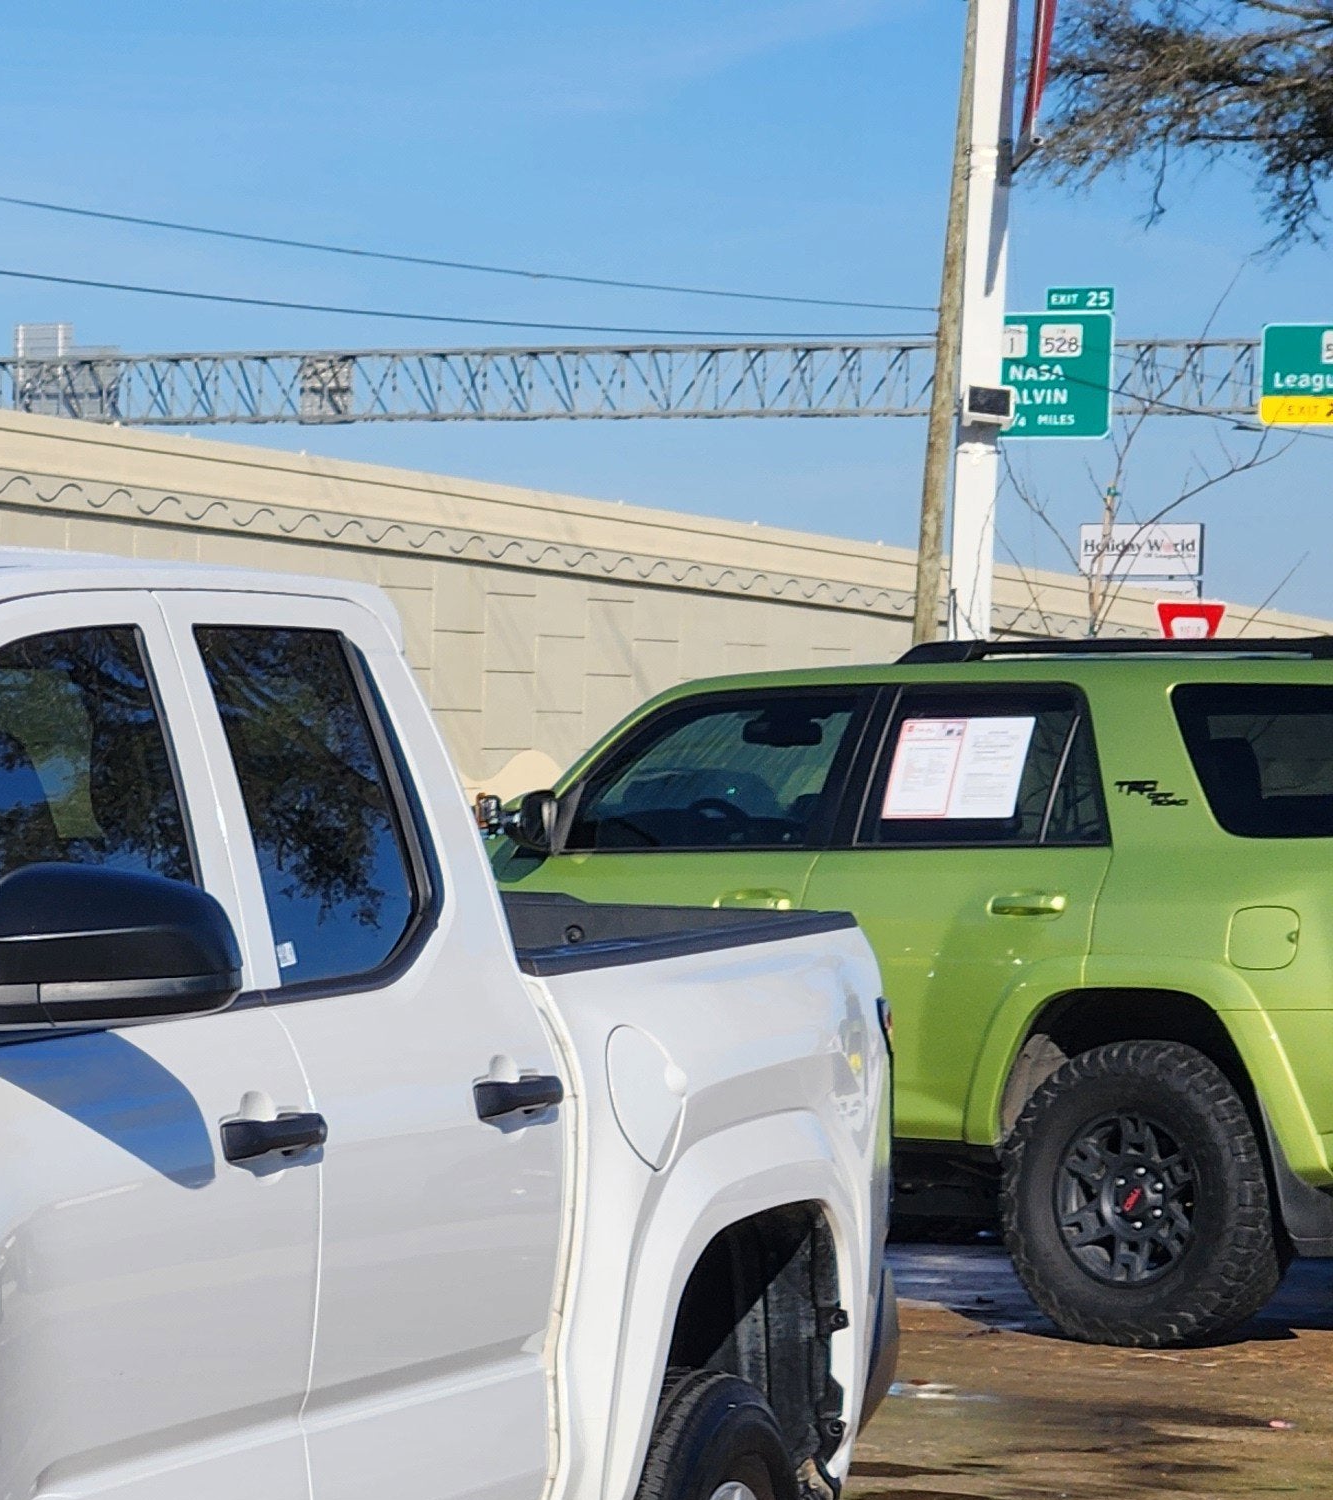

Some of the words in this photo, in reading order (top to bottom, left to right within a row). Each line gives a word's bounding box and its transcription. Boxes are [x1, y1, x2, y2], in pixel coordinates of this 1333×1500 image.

[1050, 293, 1079, 305] EXIT
[1085, 291, 1110, 307] 25
[1043, 336, 1079, 354] 528
[1009, 364, 1065, 381] NASA
[1273, 371, 1333, 392] Leagu
[1036, 414, 1075, 426] MILES
